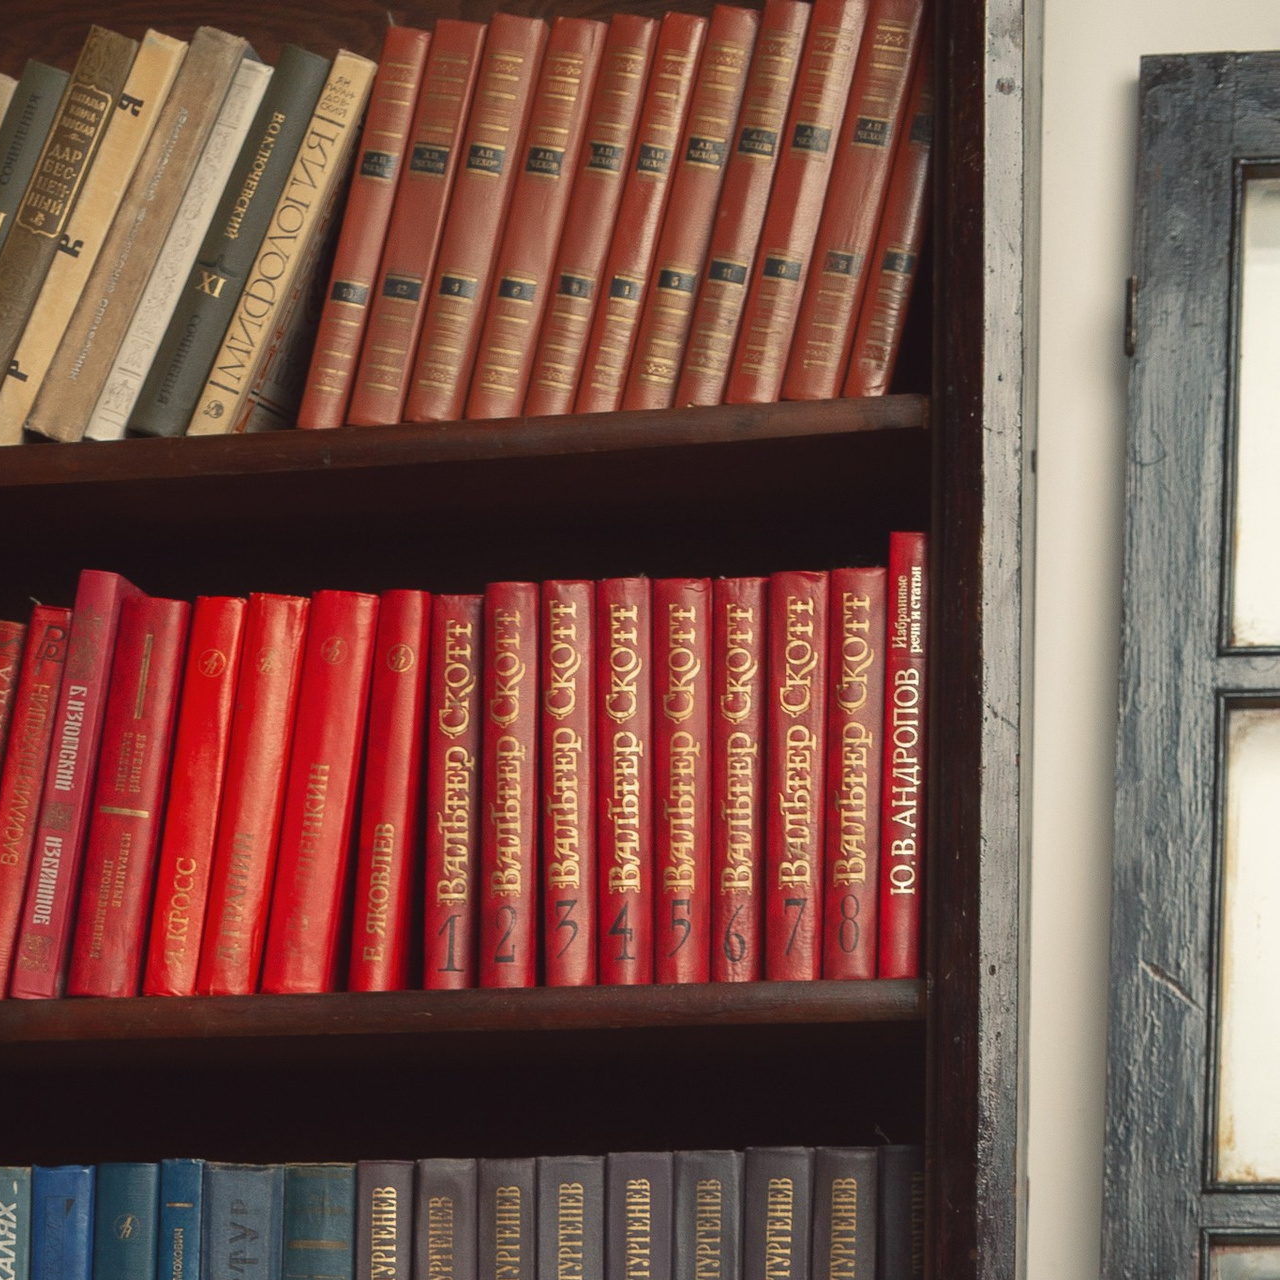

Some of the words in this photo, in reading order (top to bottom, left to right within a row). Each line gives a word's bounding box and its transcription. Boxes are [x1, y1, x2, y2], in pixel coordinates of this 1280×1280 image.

[42, 159, 77, 181] БЕС-
[48, 143, 83, 164] ДАР
[27, 192, 64, 216] НЫЙ
[197, 270, 228, 299] IX
[217, 126, 341, 385] МИФОЛОГИЯ
[892, 574, 909, 650] Избранные
[911, 565, 923, 609] статьи
[910, 622, 924, 654] речи
[891, 667, 923, 829] АНДРОПОВ
[891, 833, 916, 860] В.
[166, 855, 198, 943] КРОСС
[365, 822, 395, 936] ЯКОВЛЕВ
[890, 864, 916, 896] Ю.
[437, 913, 466, 973] 1
[493, 904, 518, 964] 2
[554, 899, 579, 960] 3
[607, 901, 637, 962] 4
[667, 898, 692, 959] 5
[723, 904, 747, 964] 6
[783, 898, 808, 957] 7
[837, 894, 861, 954] 8
